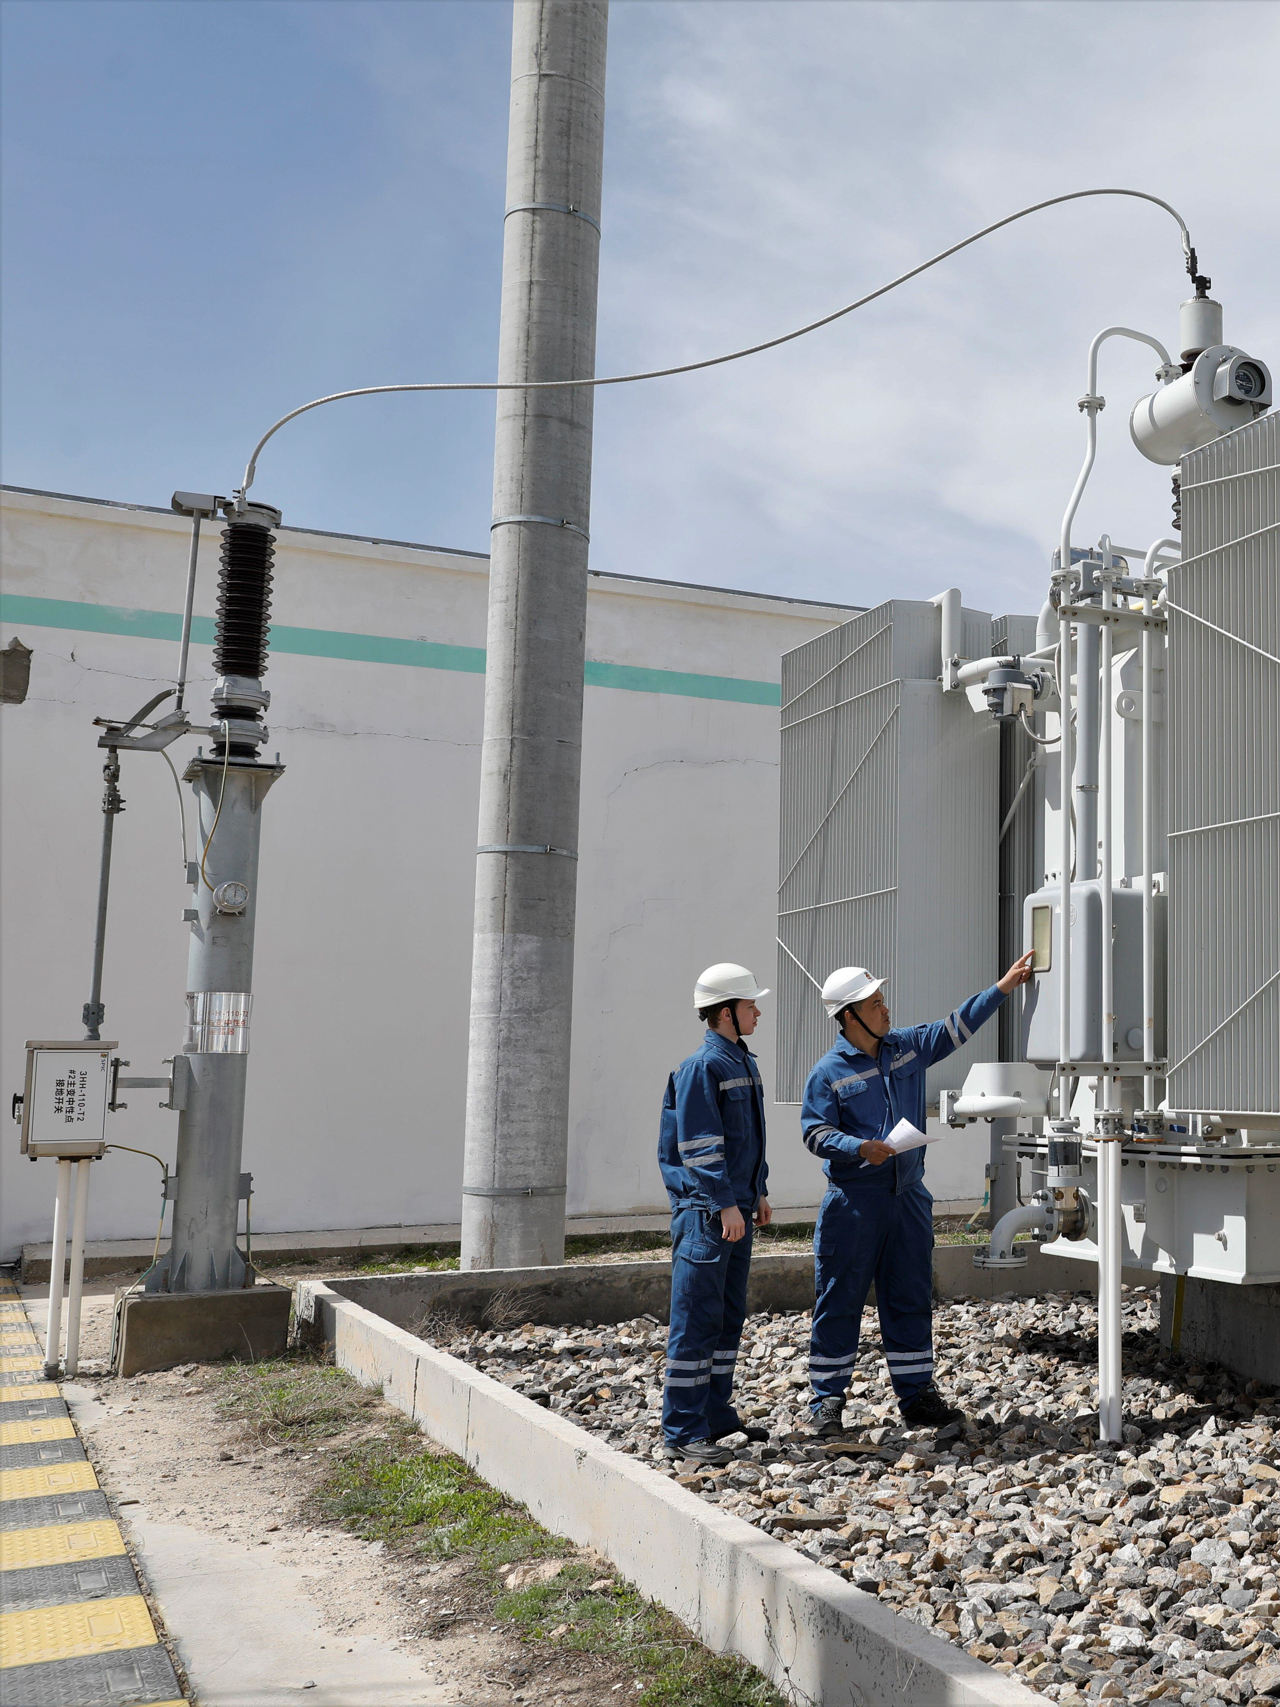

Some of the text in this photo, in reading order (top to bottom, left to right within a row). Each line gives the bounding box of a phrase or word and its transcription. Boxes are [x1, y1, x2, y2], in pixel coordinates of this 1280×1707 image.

[53, 1079, 66, 1114] 接地开关
[64, 1069, 77, 1124] #2主变中性点
